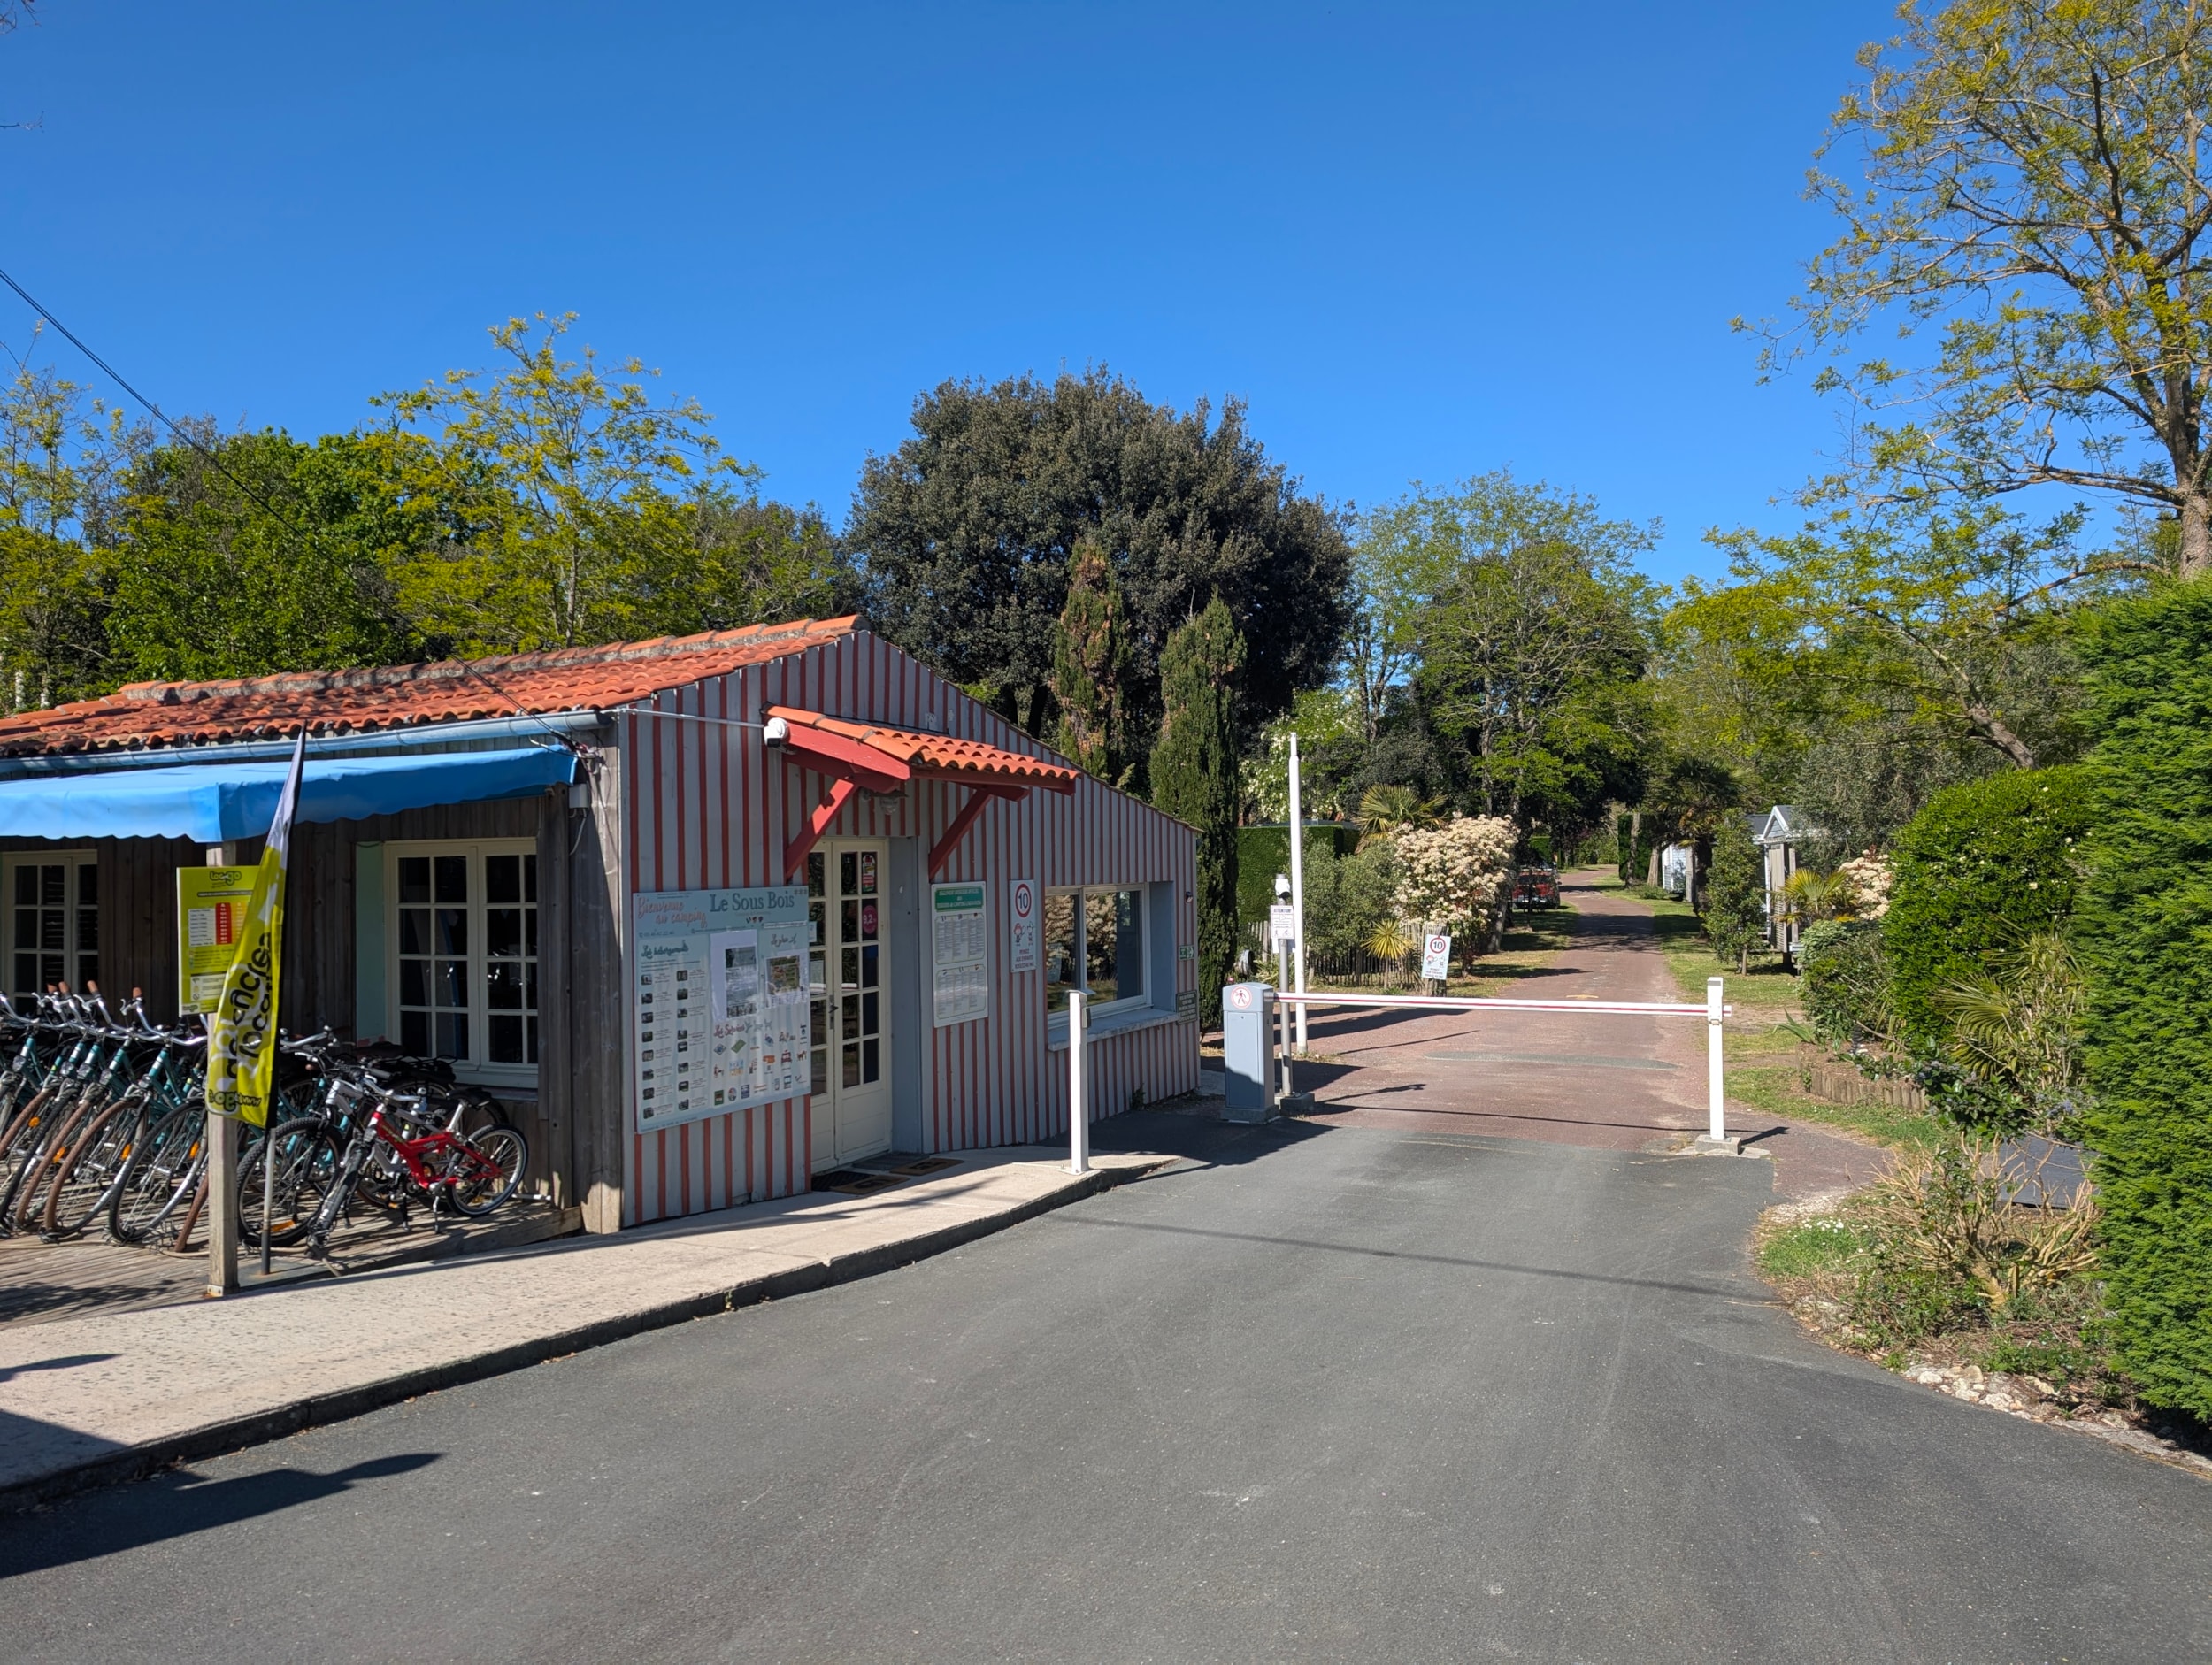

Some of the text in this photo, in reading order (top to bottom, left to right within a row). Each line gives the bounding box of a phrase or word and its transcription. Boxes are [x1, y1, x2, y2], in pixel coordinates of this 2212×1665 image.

[638, 896, 684, 918] Bienvenue
[710, 890, 795, 912] Le Sous Bois
[1018, 892, 1028, 909] 10
[671, 908, 708, 928] camping
[1433, 940, 1443, 950] 10
